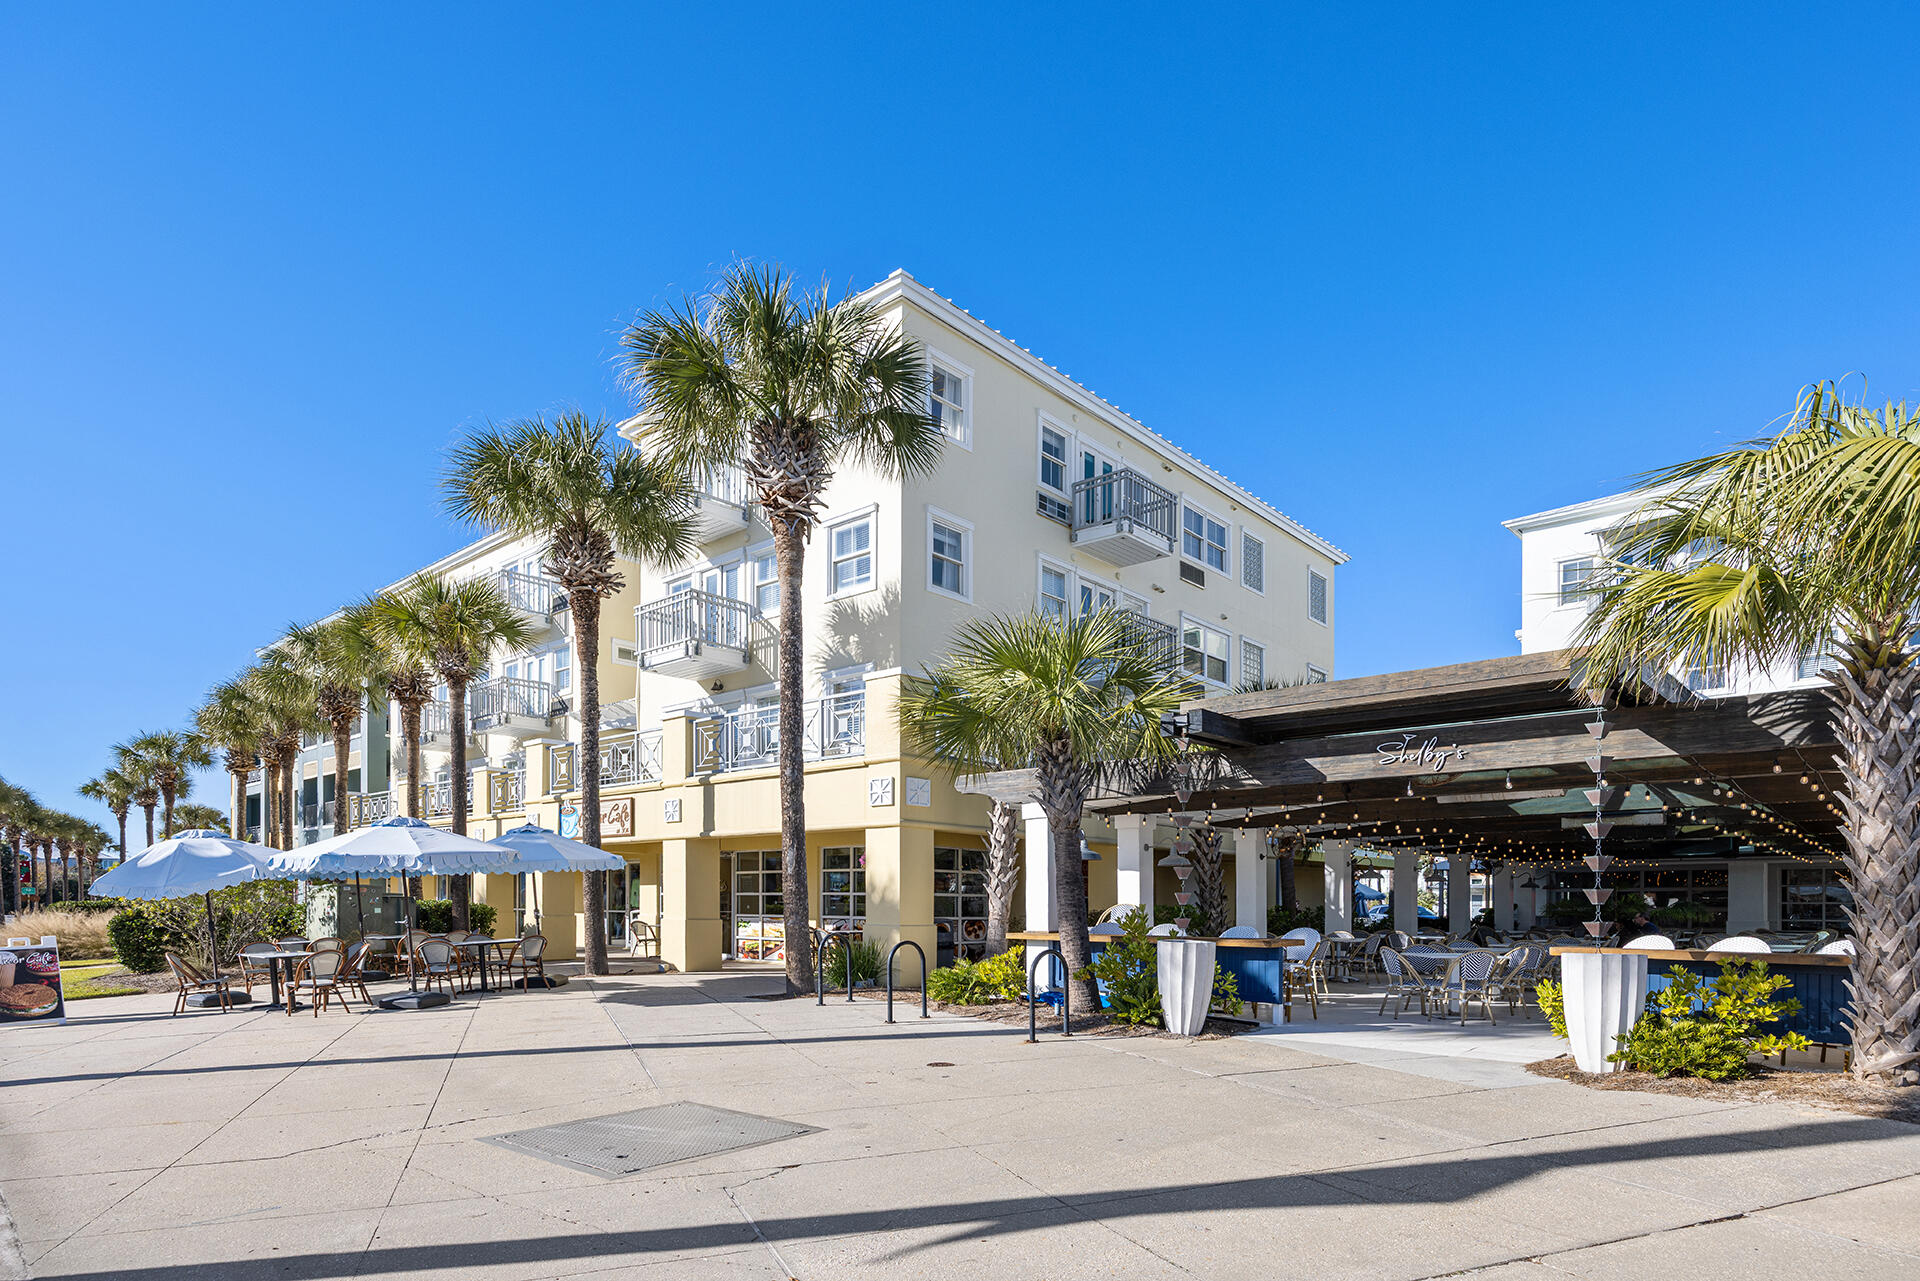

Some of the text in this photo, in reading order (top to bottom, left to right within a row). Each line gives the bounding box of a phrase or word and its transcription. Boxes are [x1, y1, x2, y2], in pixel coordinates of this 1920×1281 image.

[1376, 733, 1469, 772] Shelby's
[608, 803, 630, 827] Cafe
[26, 952, 53, 964] Cafe
